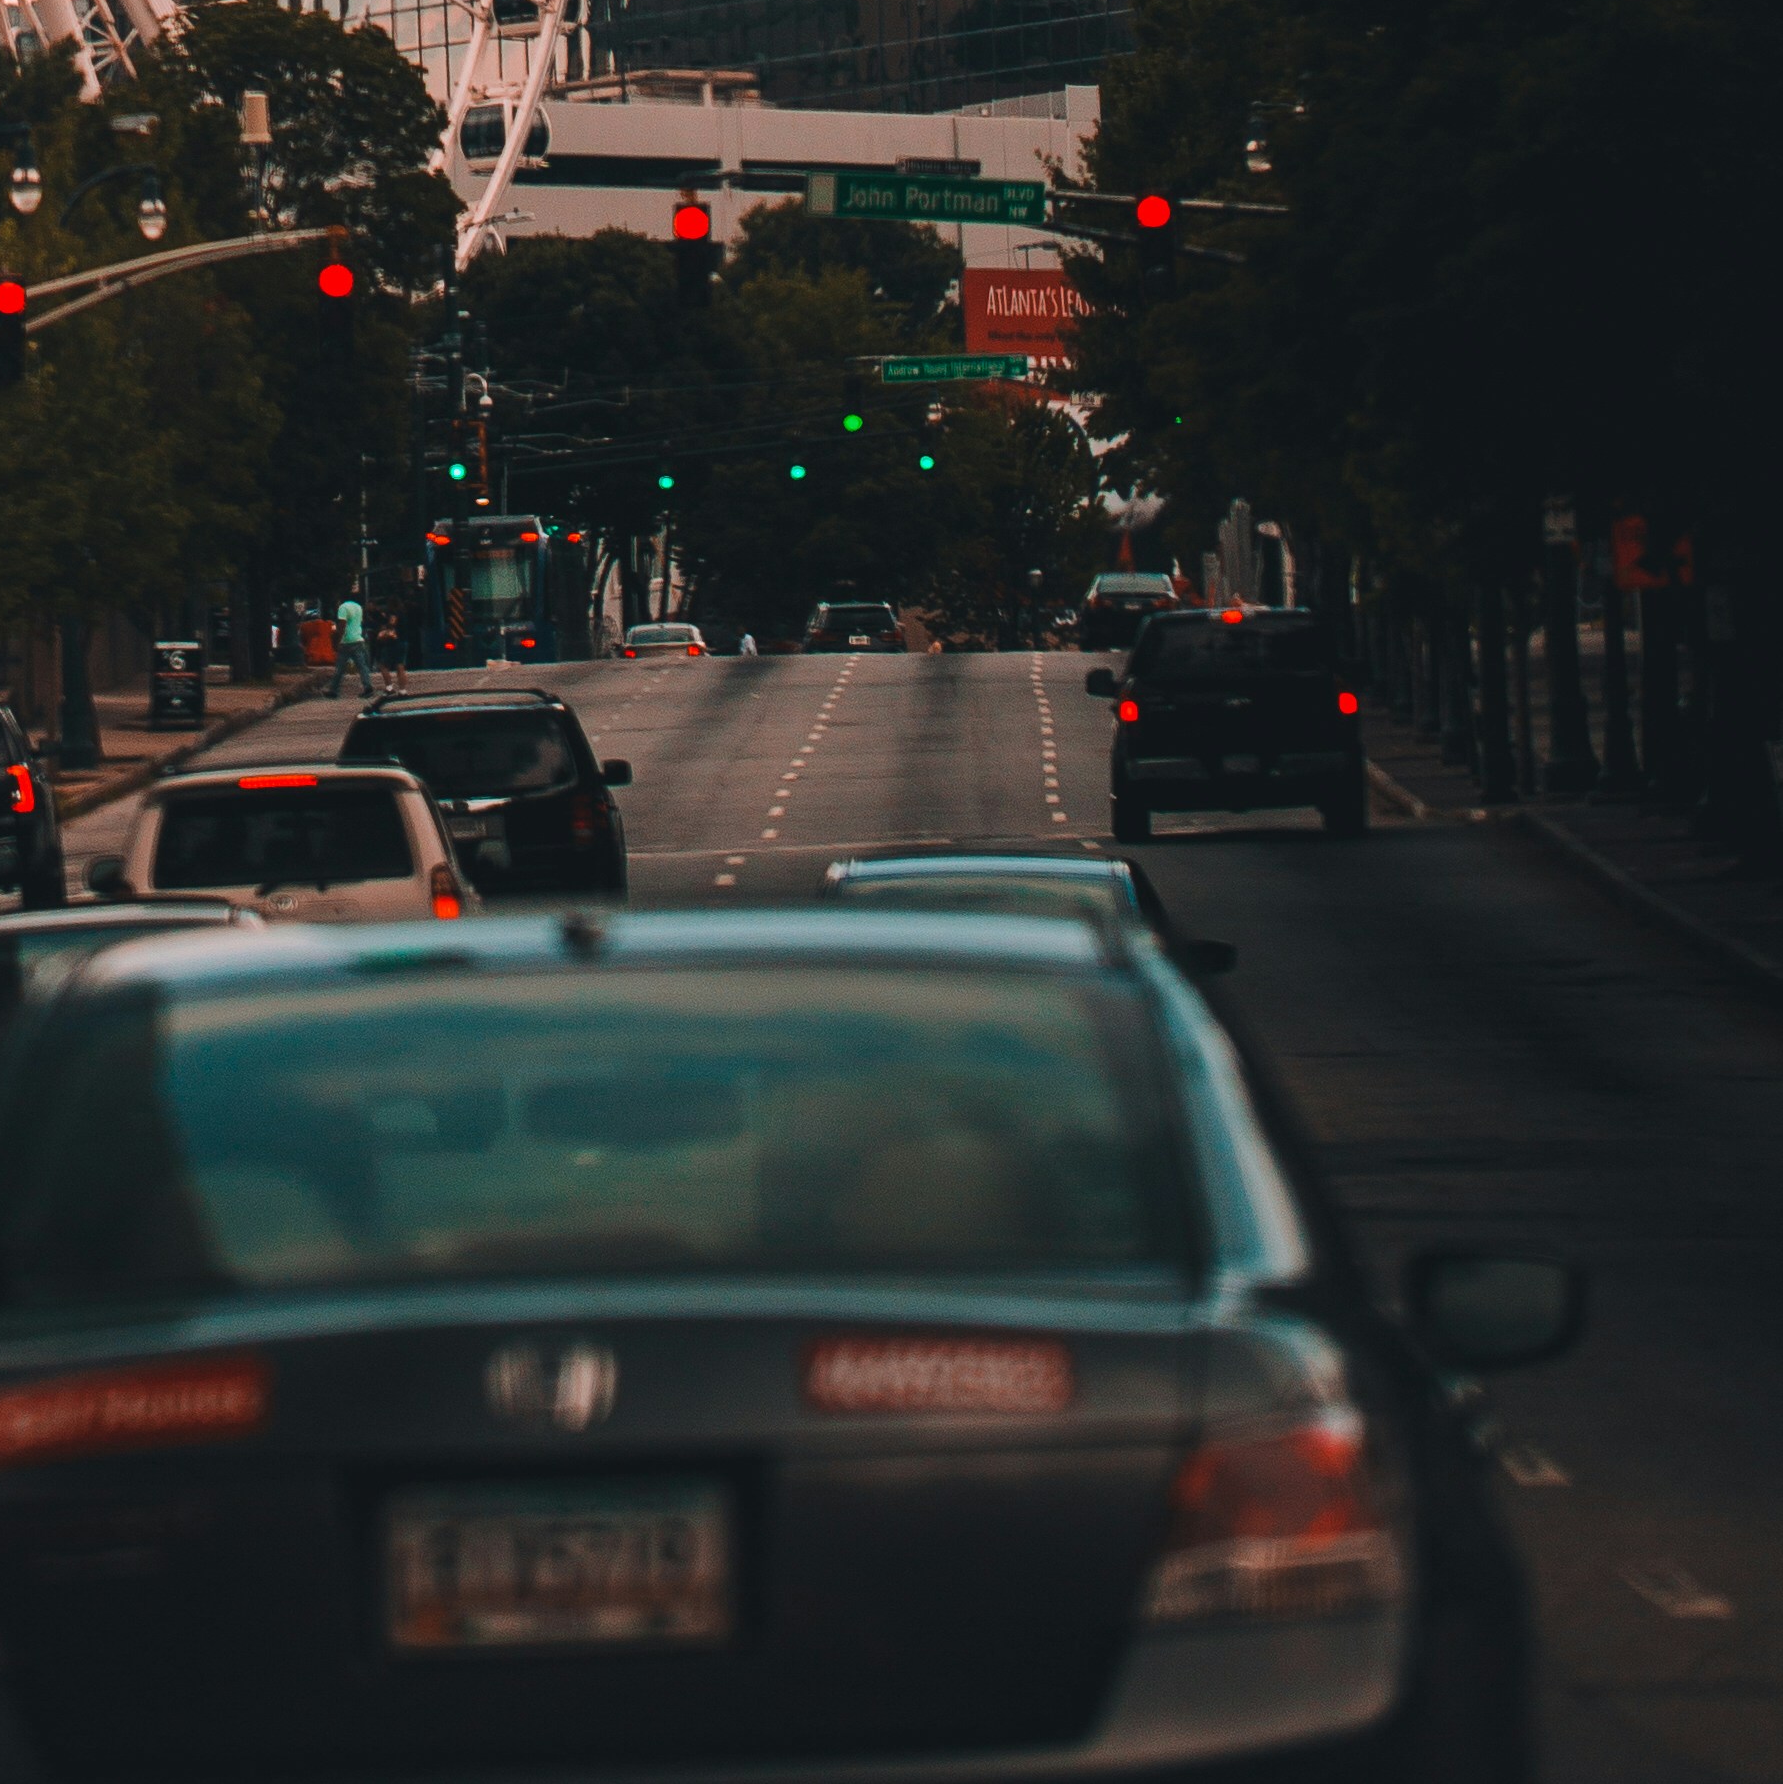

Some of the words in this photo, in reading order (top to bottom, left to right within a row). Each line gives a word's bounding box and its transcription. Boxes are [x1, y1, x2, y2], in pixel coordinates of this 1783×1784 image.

[843, 184, 895, 209] John
[905, 186, 1000, 214] Portman
[987, 285, 1058, 318] ATLANTA'S
